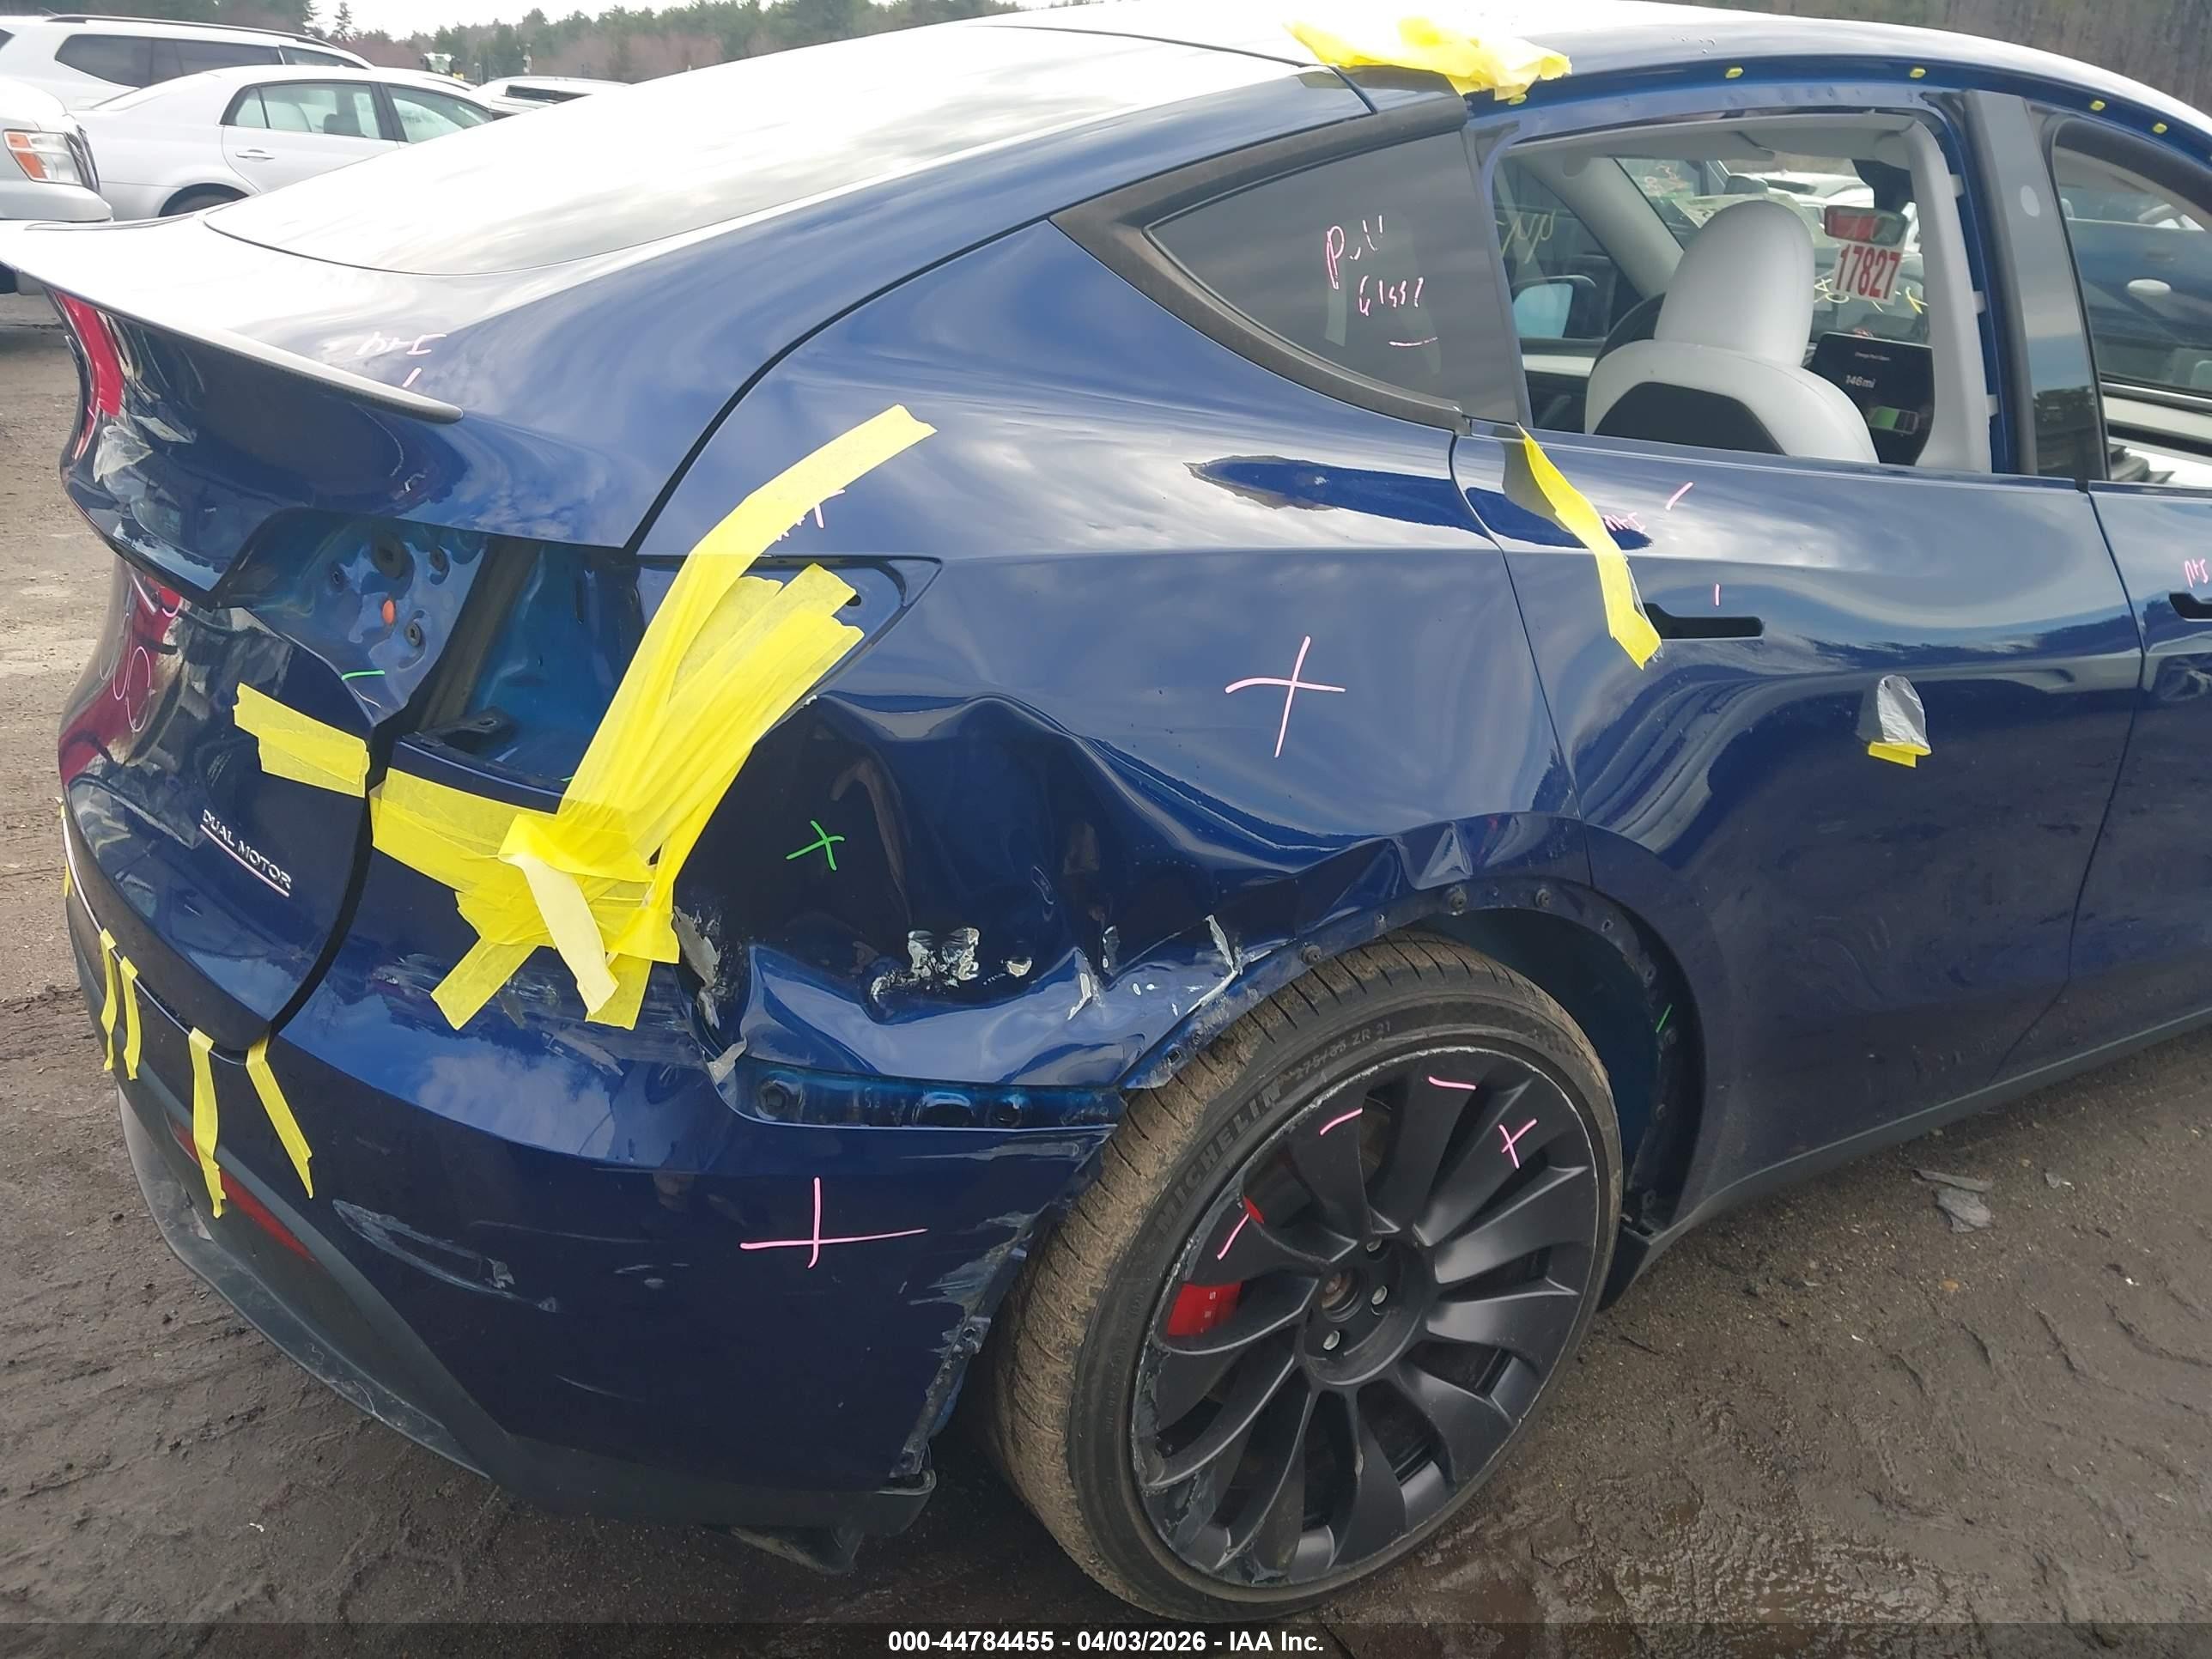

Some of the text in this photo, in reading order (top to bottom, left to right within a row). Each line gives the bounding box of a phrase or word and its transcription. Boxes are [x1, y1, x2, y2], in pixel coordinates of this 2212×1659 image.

[1835, 243, 1902, 301] 17827
[202, 808, 293, 890] DUAL MOTOR
[1154, 1079, 1281, 1236] MICHELIN
